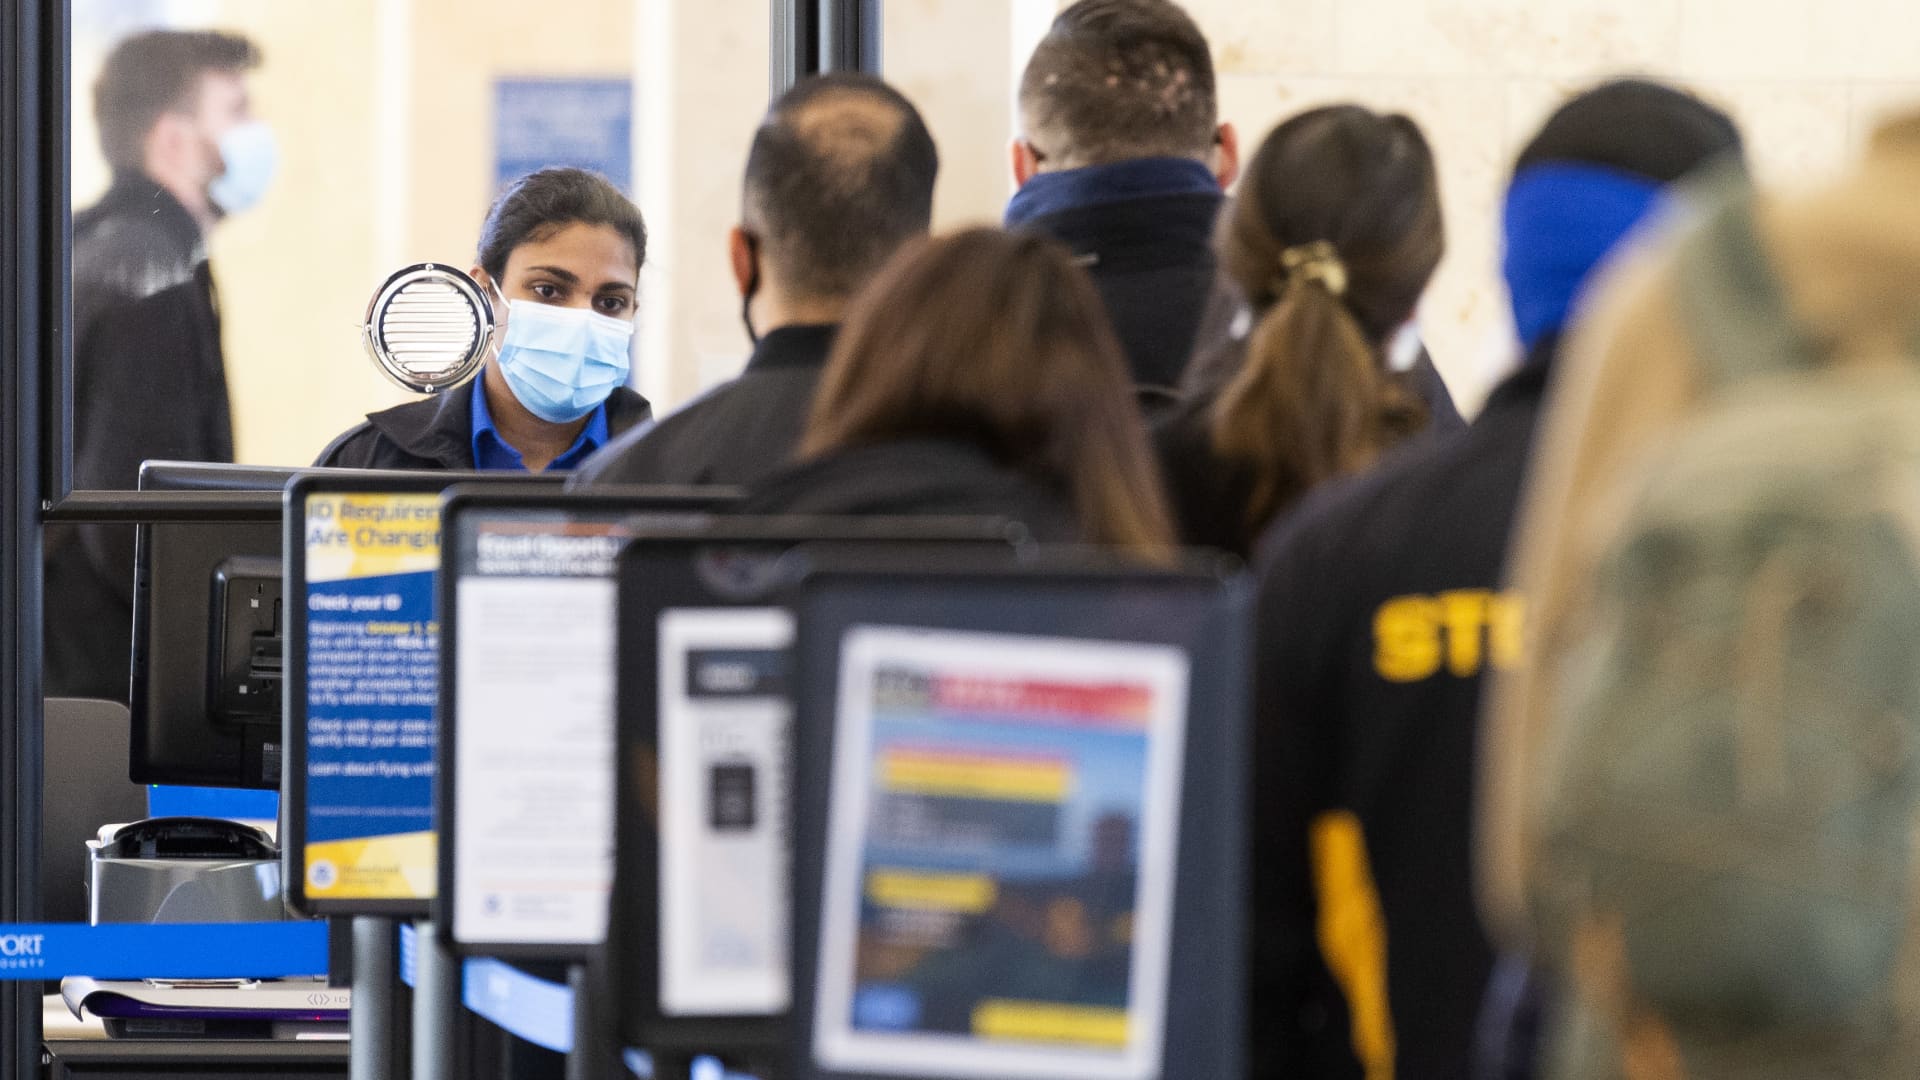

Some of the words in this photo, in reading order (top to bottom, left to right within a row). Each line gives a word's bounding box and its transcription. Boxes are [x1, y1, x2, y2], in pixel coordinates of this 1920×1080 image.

[308, 529, 348, 546] Are
[309, 593, 348, 610] Check
[350, 595, 382, 612] your
[383, 593, 402, 610] ID
